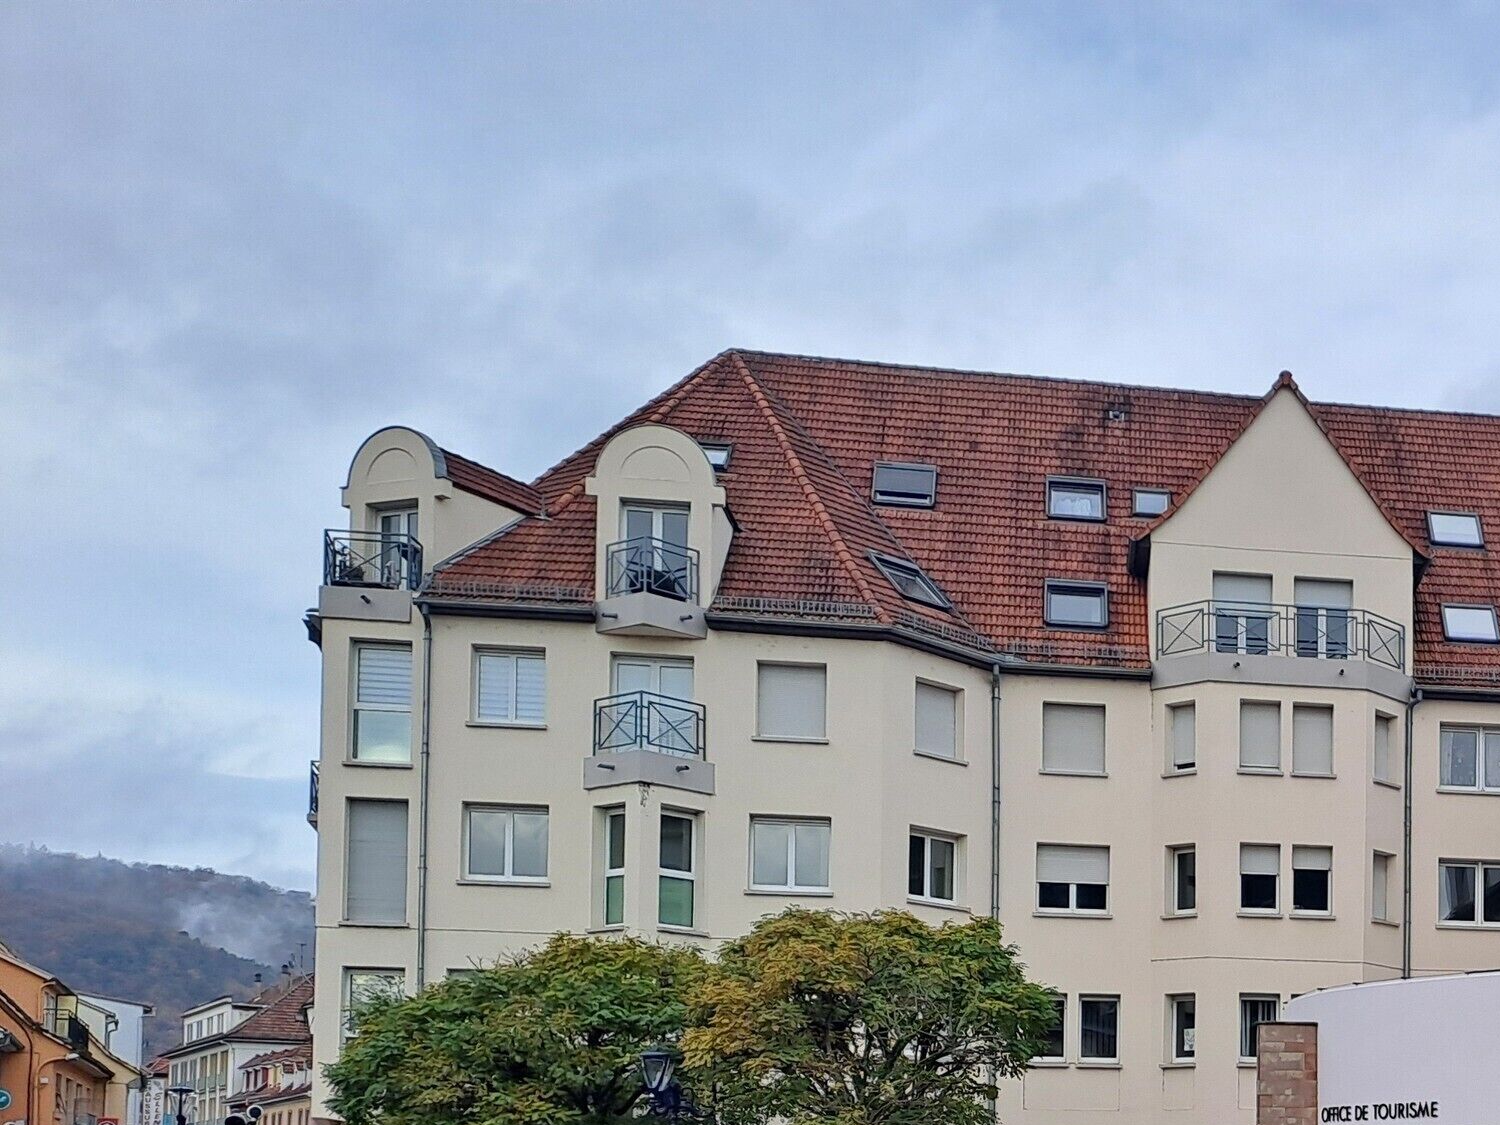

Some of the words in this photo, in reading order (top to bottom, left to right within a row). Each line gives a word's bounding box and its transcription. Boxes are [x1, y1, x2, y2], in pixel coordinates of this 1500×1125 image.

[1321, 1106, 1352, 1123] OFFICE
[1355, 1105, 1368, 1121] DE
[1372, 1101, 1439, 1120] TOURISME
